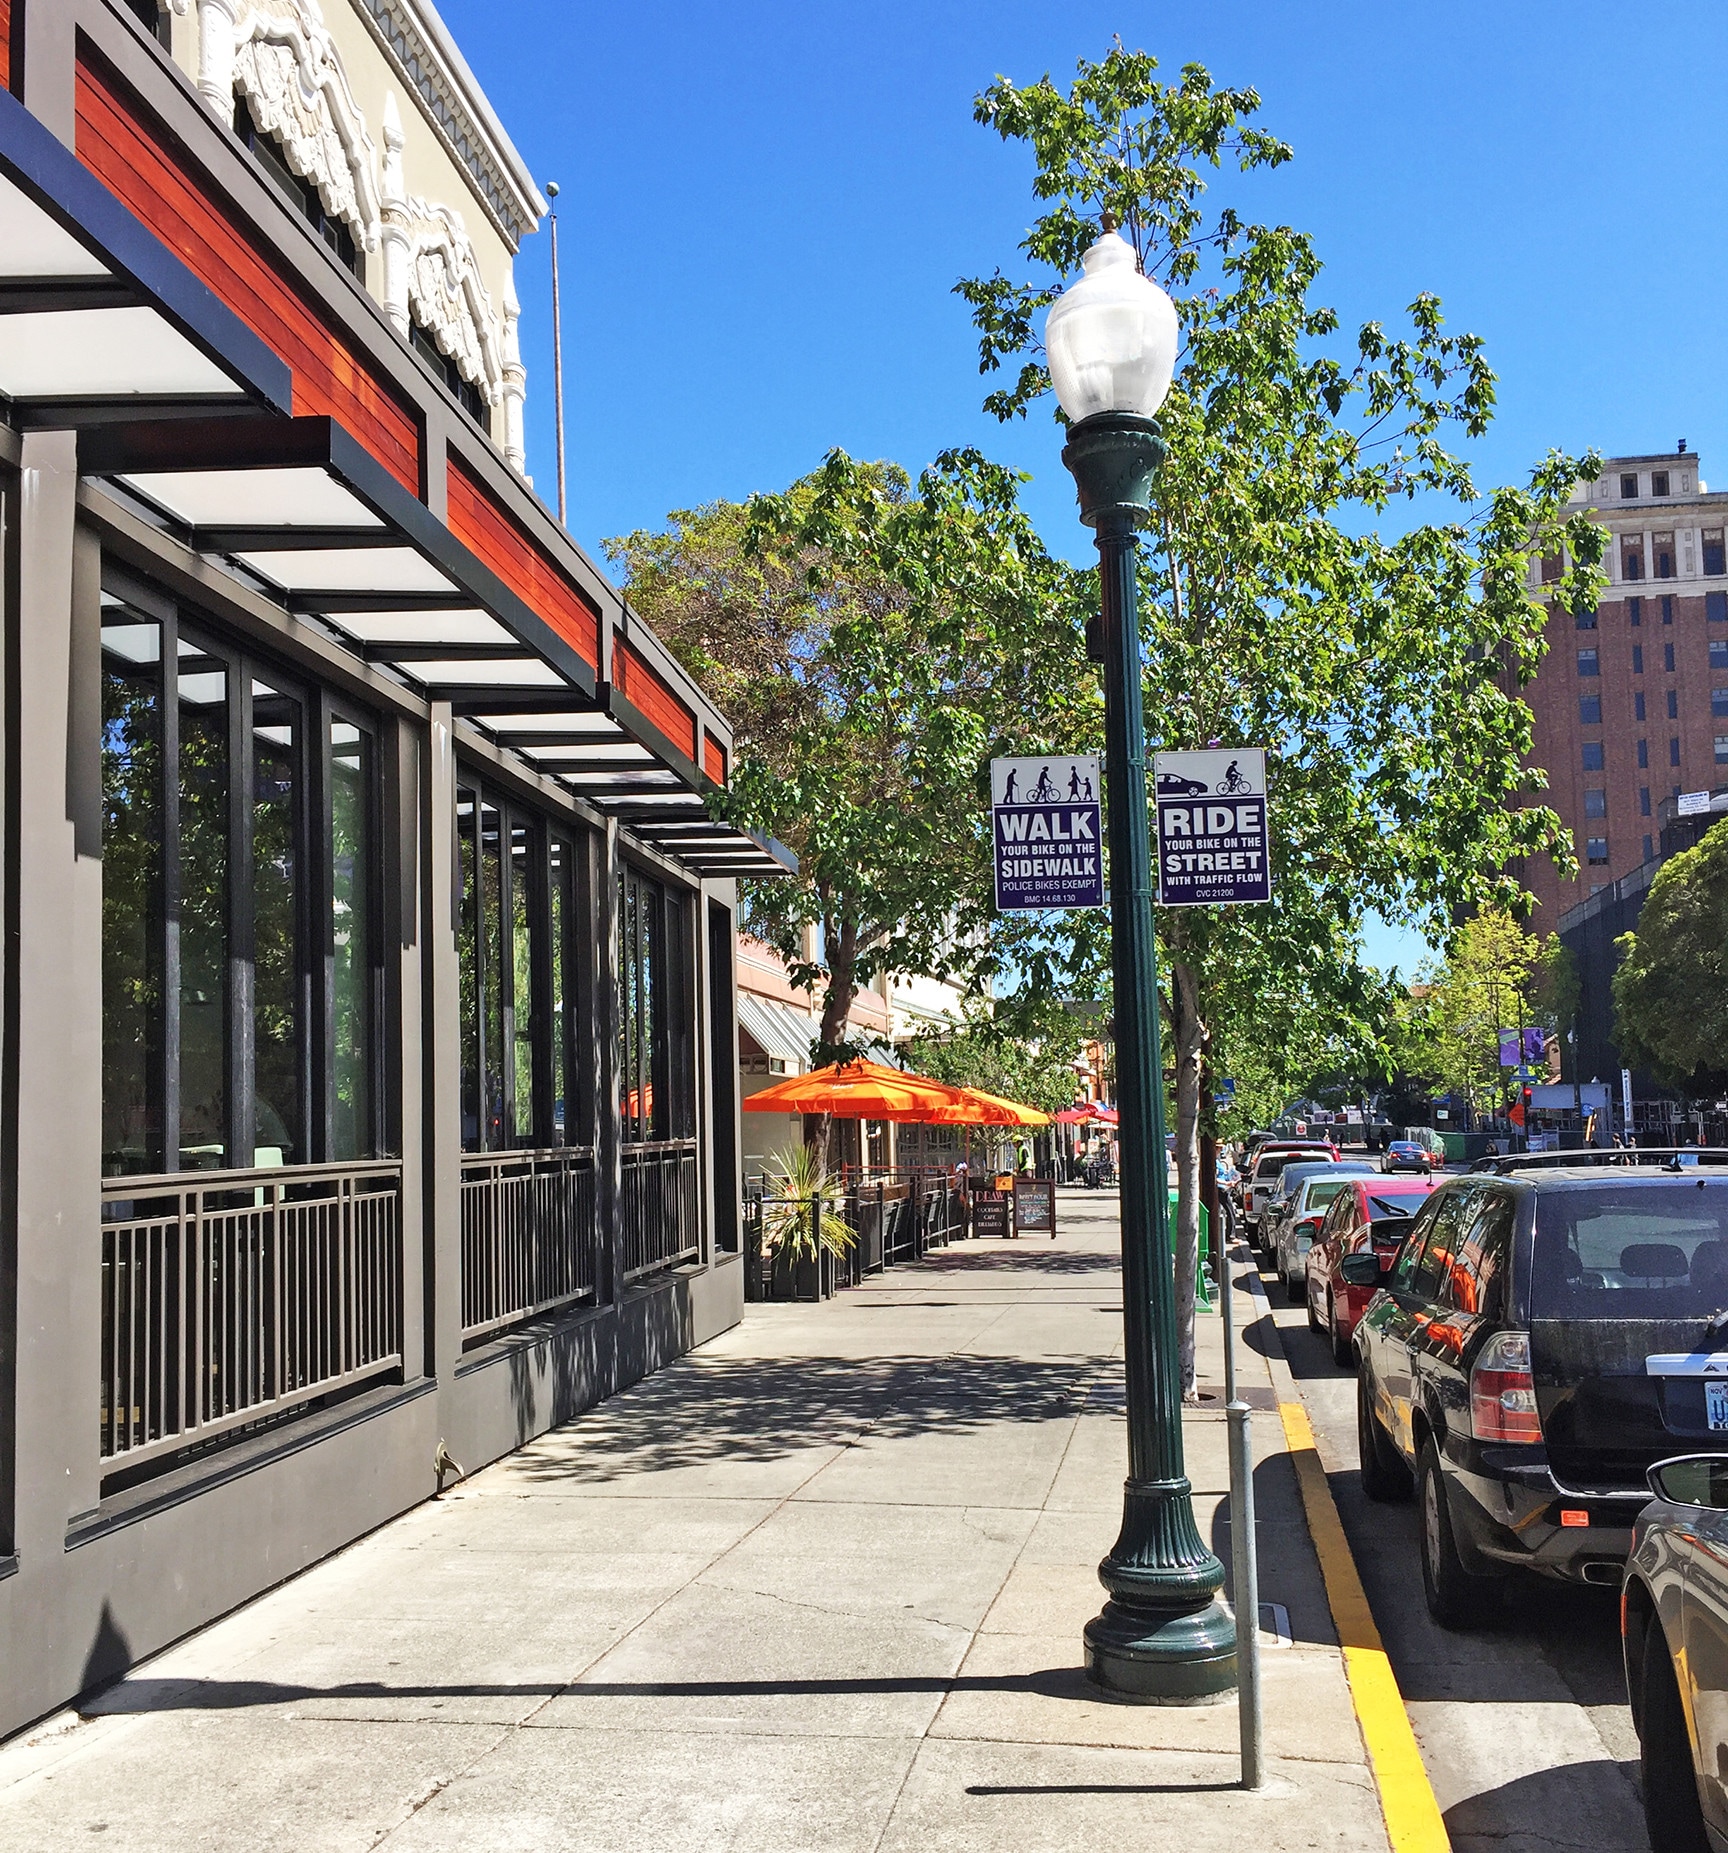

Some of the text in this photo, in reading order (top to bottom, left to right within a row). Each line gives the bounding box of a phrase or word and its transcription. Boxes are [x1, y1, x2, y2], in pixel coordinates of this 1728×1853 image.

[1000, 812, 1094, 841] WALK
[1164, 805, 1261, 836] RIDE
[1001, 843, 1095, 856] YOUR BIKE ON THE
[1165, 837, 1261, 850] YOUR BIKE ON THE
[1001, 858, 1096, 878] SIDEWALK
[1166, 851, 1261, 872] STREET
[1003, 879, 1096, 891] POLICE BIKES EXEMPT
[1167, 873, 1262, 886] WITH TRAFFIC FLOW
[1196, 889, 1234, 898] CVC 21200
